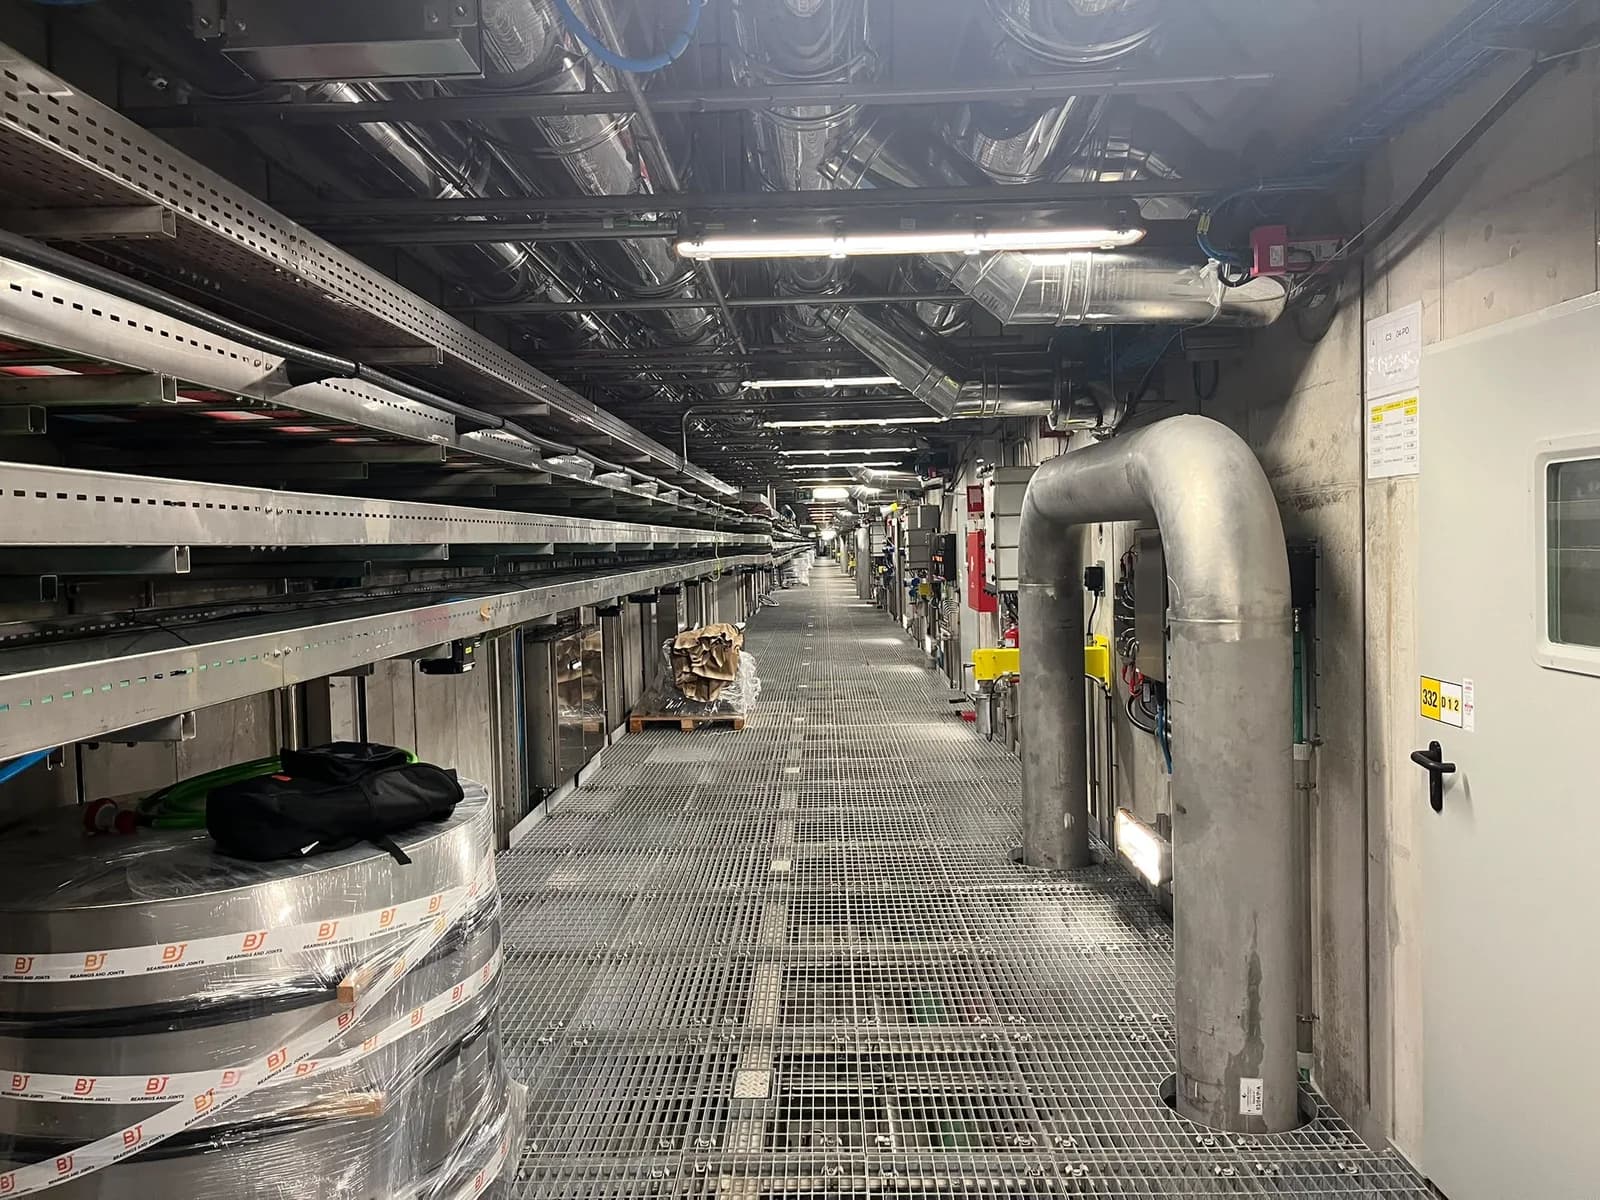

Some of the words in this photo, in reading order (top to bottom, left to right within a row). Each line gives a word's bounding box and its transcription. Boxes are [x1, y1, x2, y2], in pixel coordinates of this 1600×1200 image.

[1422, 688, 1438, 708] 332
[380, 908, 397, 928] BJ
[317, 921, 340, 941] BJ
[242, 932, 268, 952] BJ
[83, 953, 108, 972] BJ
[162, 944, 188, 963] BJ
[14, 957, 35, 974] BJ
[267, 1047, 287, 1073] BJ
[11, 1074, 30, 1091] BJ
[73, 1078, 96, 1095] BJ
[145, 1077, 169, 1095] BJ
[123, 1125, 142, 1149] BJ
[56, 1153, 74, 1175] BJ
[0, 1173, 15, 1193] BJ
